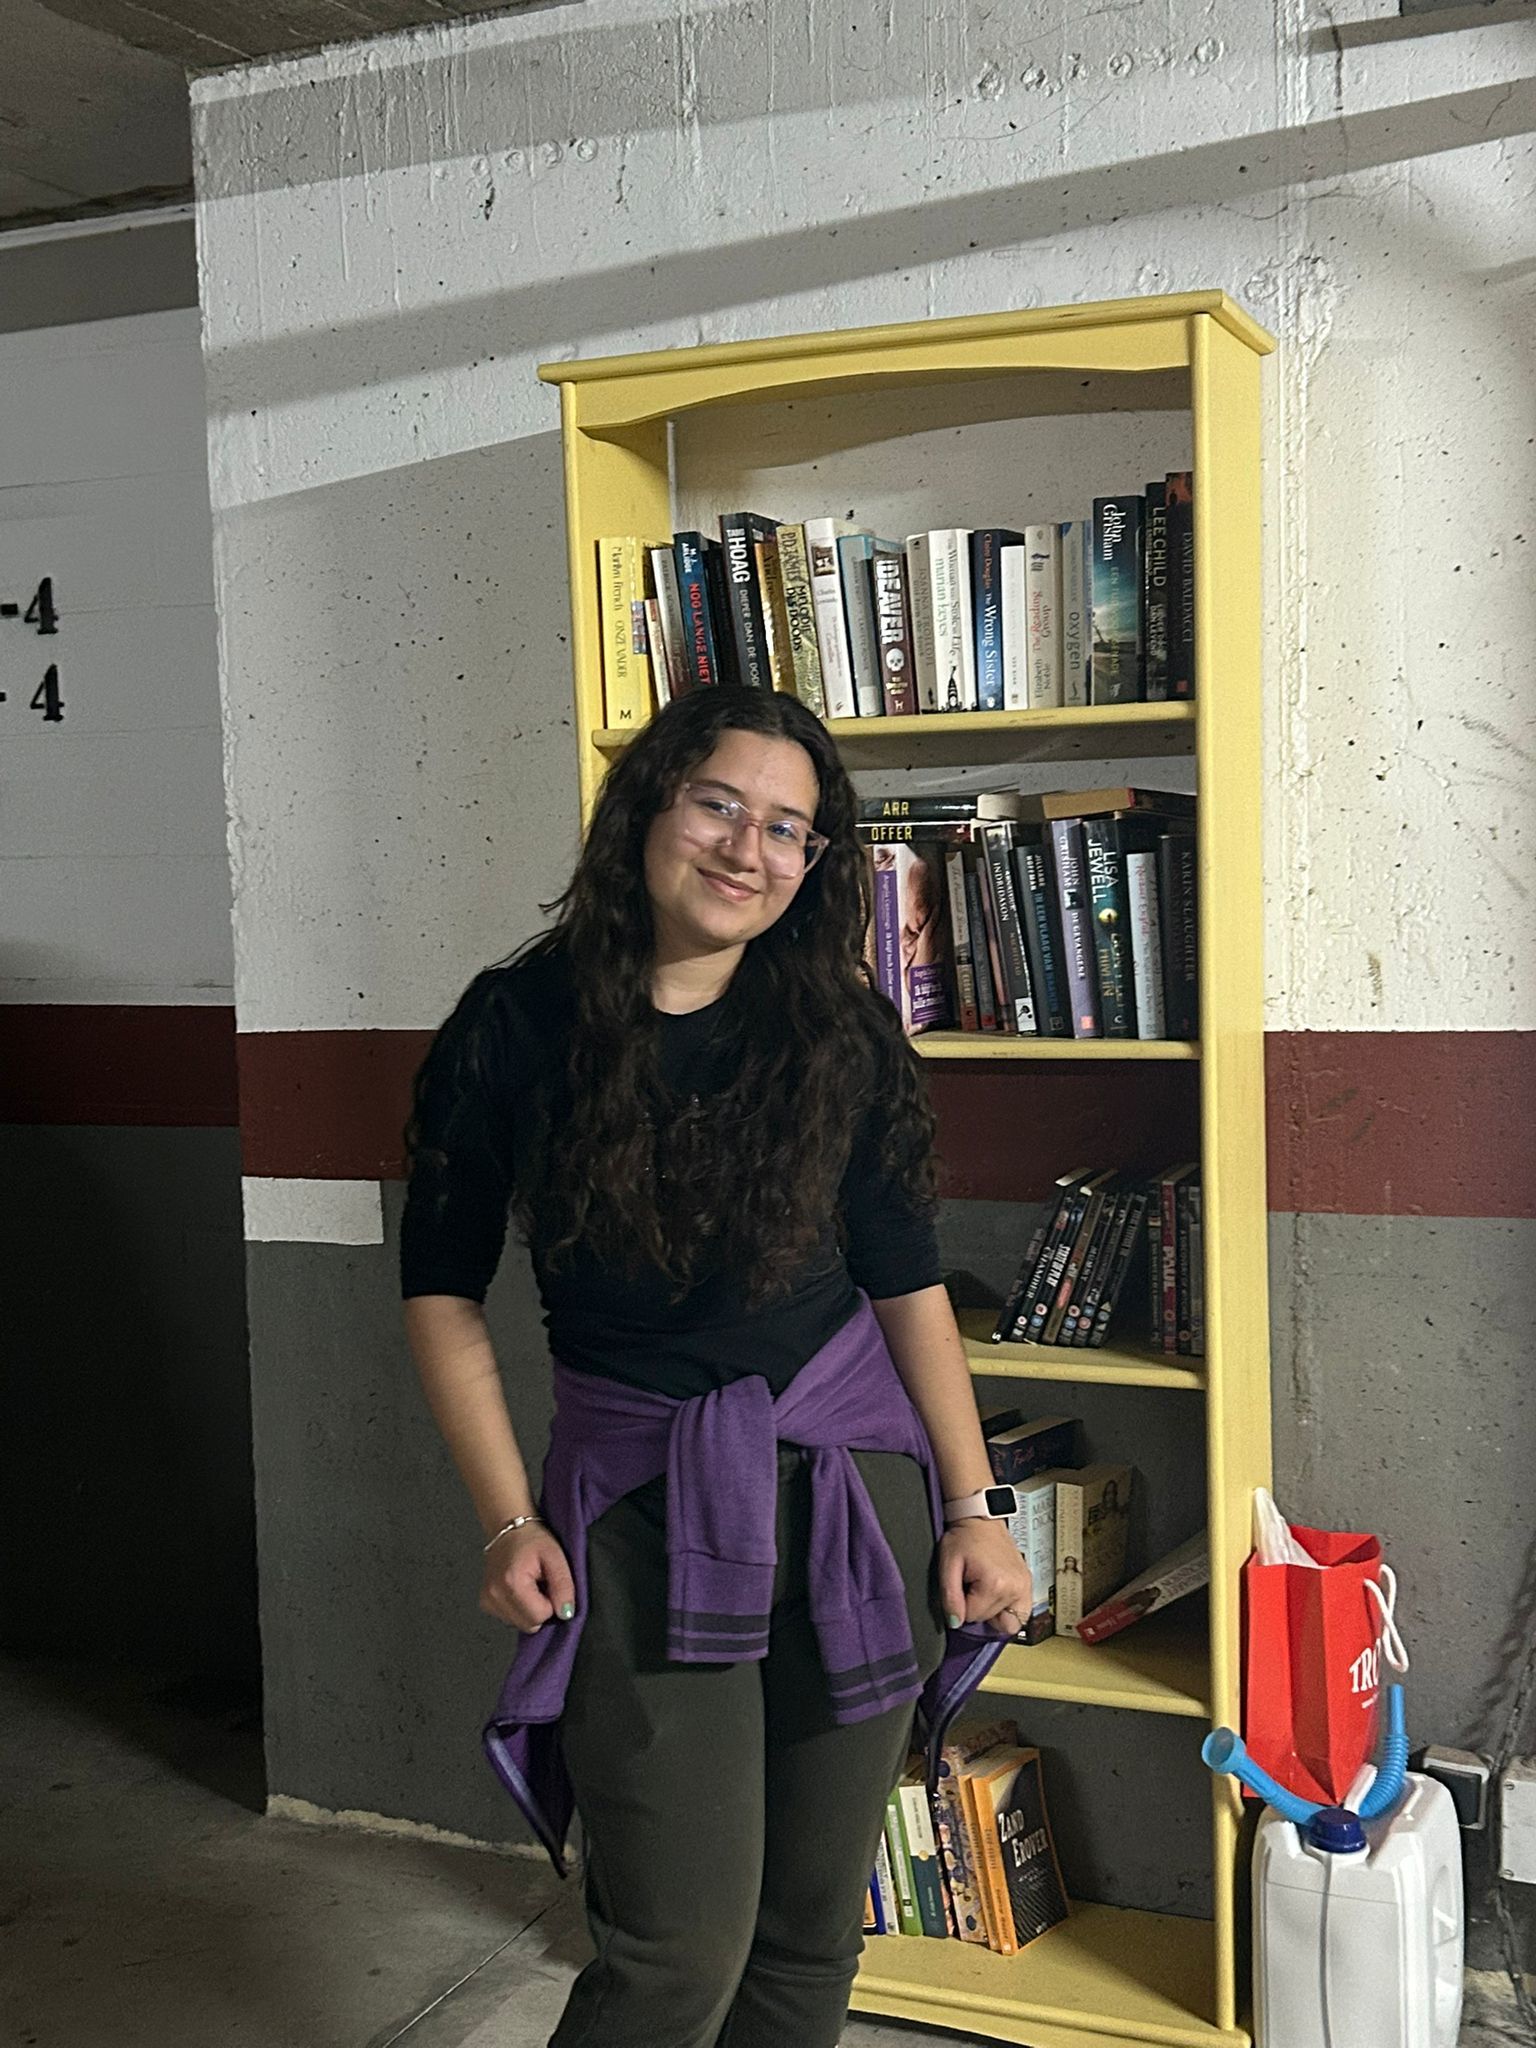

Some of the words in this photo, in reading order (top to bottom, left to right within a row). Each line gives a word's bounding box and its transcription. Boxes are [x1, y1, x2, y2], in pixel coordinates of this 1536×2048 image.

[1102, 504, 1118, 561] Grisham
[1111, 512, 1126, 543] John
[1153, 507, 1166, 536] LEE
[612, 547, 624, 578] Marilyn
[682, 543, 692, 573] ARLIDGE
[728, 537, 750, 582] HOAG
[984, 534, 993, 556] Claire
[1153, 538, 1166, 587] CHILD
[1182, 532, 1192, 568] DAVID
[918, 568, 928, 610] JOANNA
[935, 558, 948, 601] marian
[984, 558, 993, 589] Douglas
[613, 581, 625, 610] French
[689, 583, 702, 608] NOG
[739, 590, 752, 618] DIEPER
[876, 567, 904, 644] DEAVER
[1029, 592, 1042, 632] Reading
[1182, 579, 1192, 643] BALDACCI
[614, 620, 626, 645] ONZE
[692, 612, 706, 652] LANGE
[743, 622, 755, 642] DAN
[789, 609, 802, 651] DOODS
[981, 605, 997, 648] Wrong
[1042, 605, 1052, 638] Group
[747, 647, 756, 658] DE
[1065, 612, 1082, 670] oxygen
[617, 649, 627, 677] VADER
[697, 656, 711, 684] NIET
[986, 650, 998, 686] Sister
[620, 710, 632, 719] M
[871, 826, 913, 841] OFFER
[1026, 855, 1037, 891] HOFFMAN
[1058, 836, 1071, 888] GRISHAM
[1069, 857, 1079, 885] JOHN
[1087, 839, 1106, 903] JEWELL
[1103, 851, 1118, 888] LISA
[1181, 852, 1192, 895] KARIN
[993, 862, 1008, 921] INDRIDASON
[1071, 912, 1079, 923] DE
[1073, 925, 1085, 979] GEVANGENE
[1184, 901, 1195, 981] SLAUGHTER
[1101, 981, 1115, 997] IN
[1025, 1246, 1053, 1300] CHAMBER
[1163, 1245, 1175, 1292] PAUL
[998, 1809, 1025, 1844] ZAND
